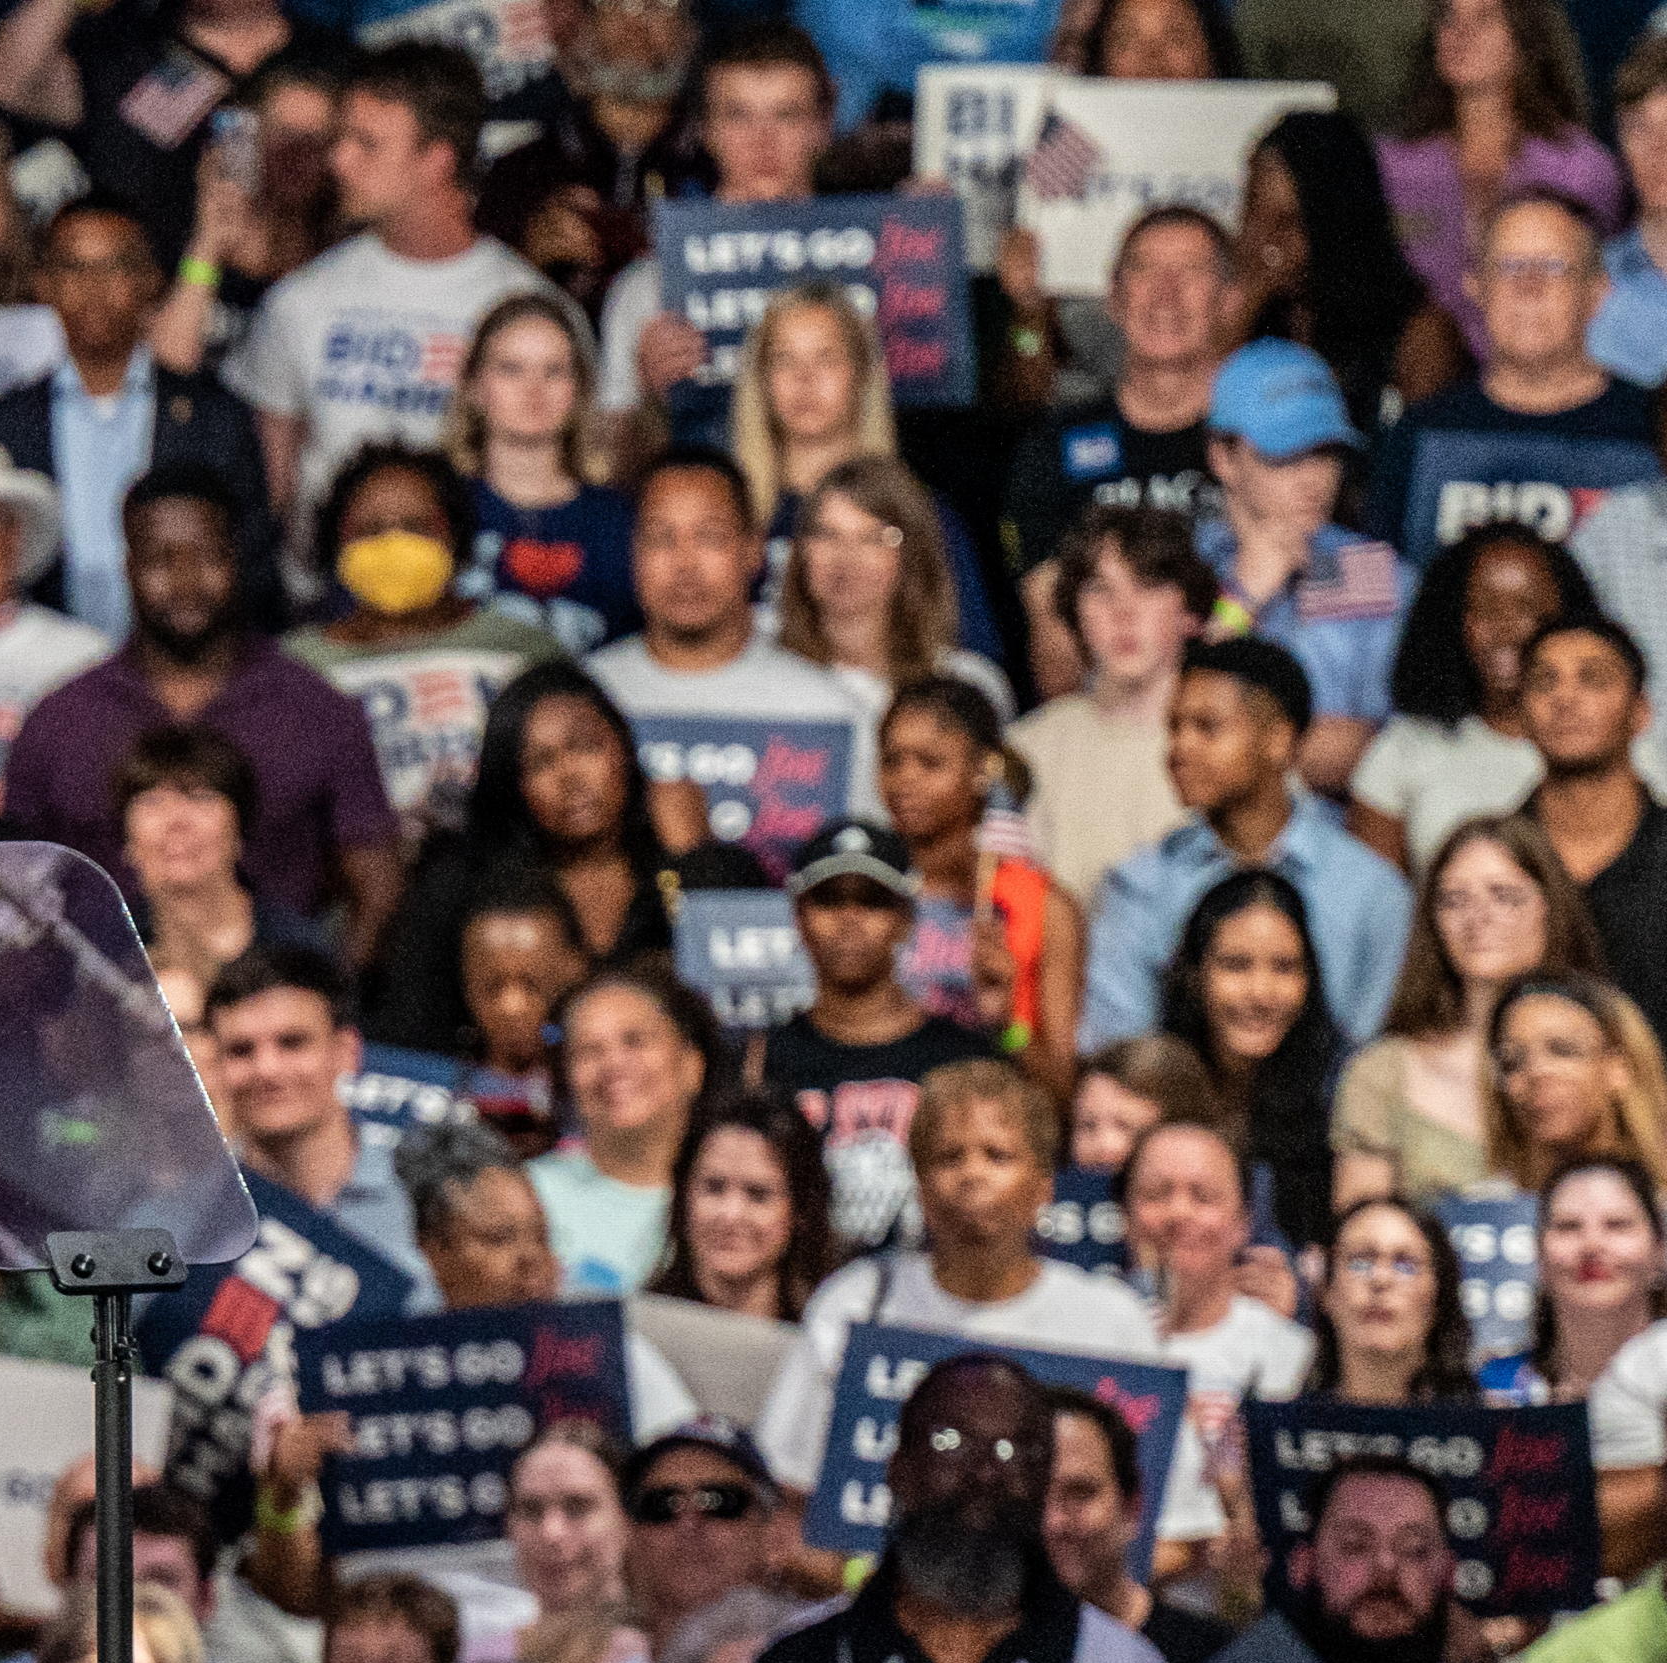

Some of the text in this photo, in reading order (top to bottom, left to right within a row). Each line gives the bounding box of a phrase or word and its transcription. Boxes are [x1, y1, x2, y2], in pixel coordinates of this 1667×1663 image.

[321, 1342, 454, 1398] LET'S
[454, 1338, 528, 1388] GO
[355, 1411, 465, 1458] ET'S
[466, 1405, 535, 1450] GO
[338, 1476, 468, 1524] LET'S
